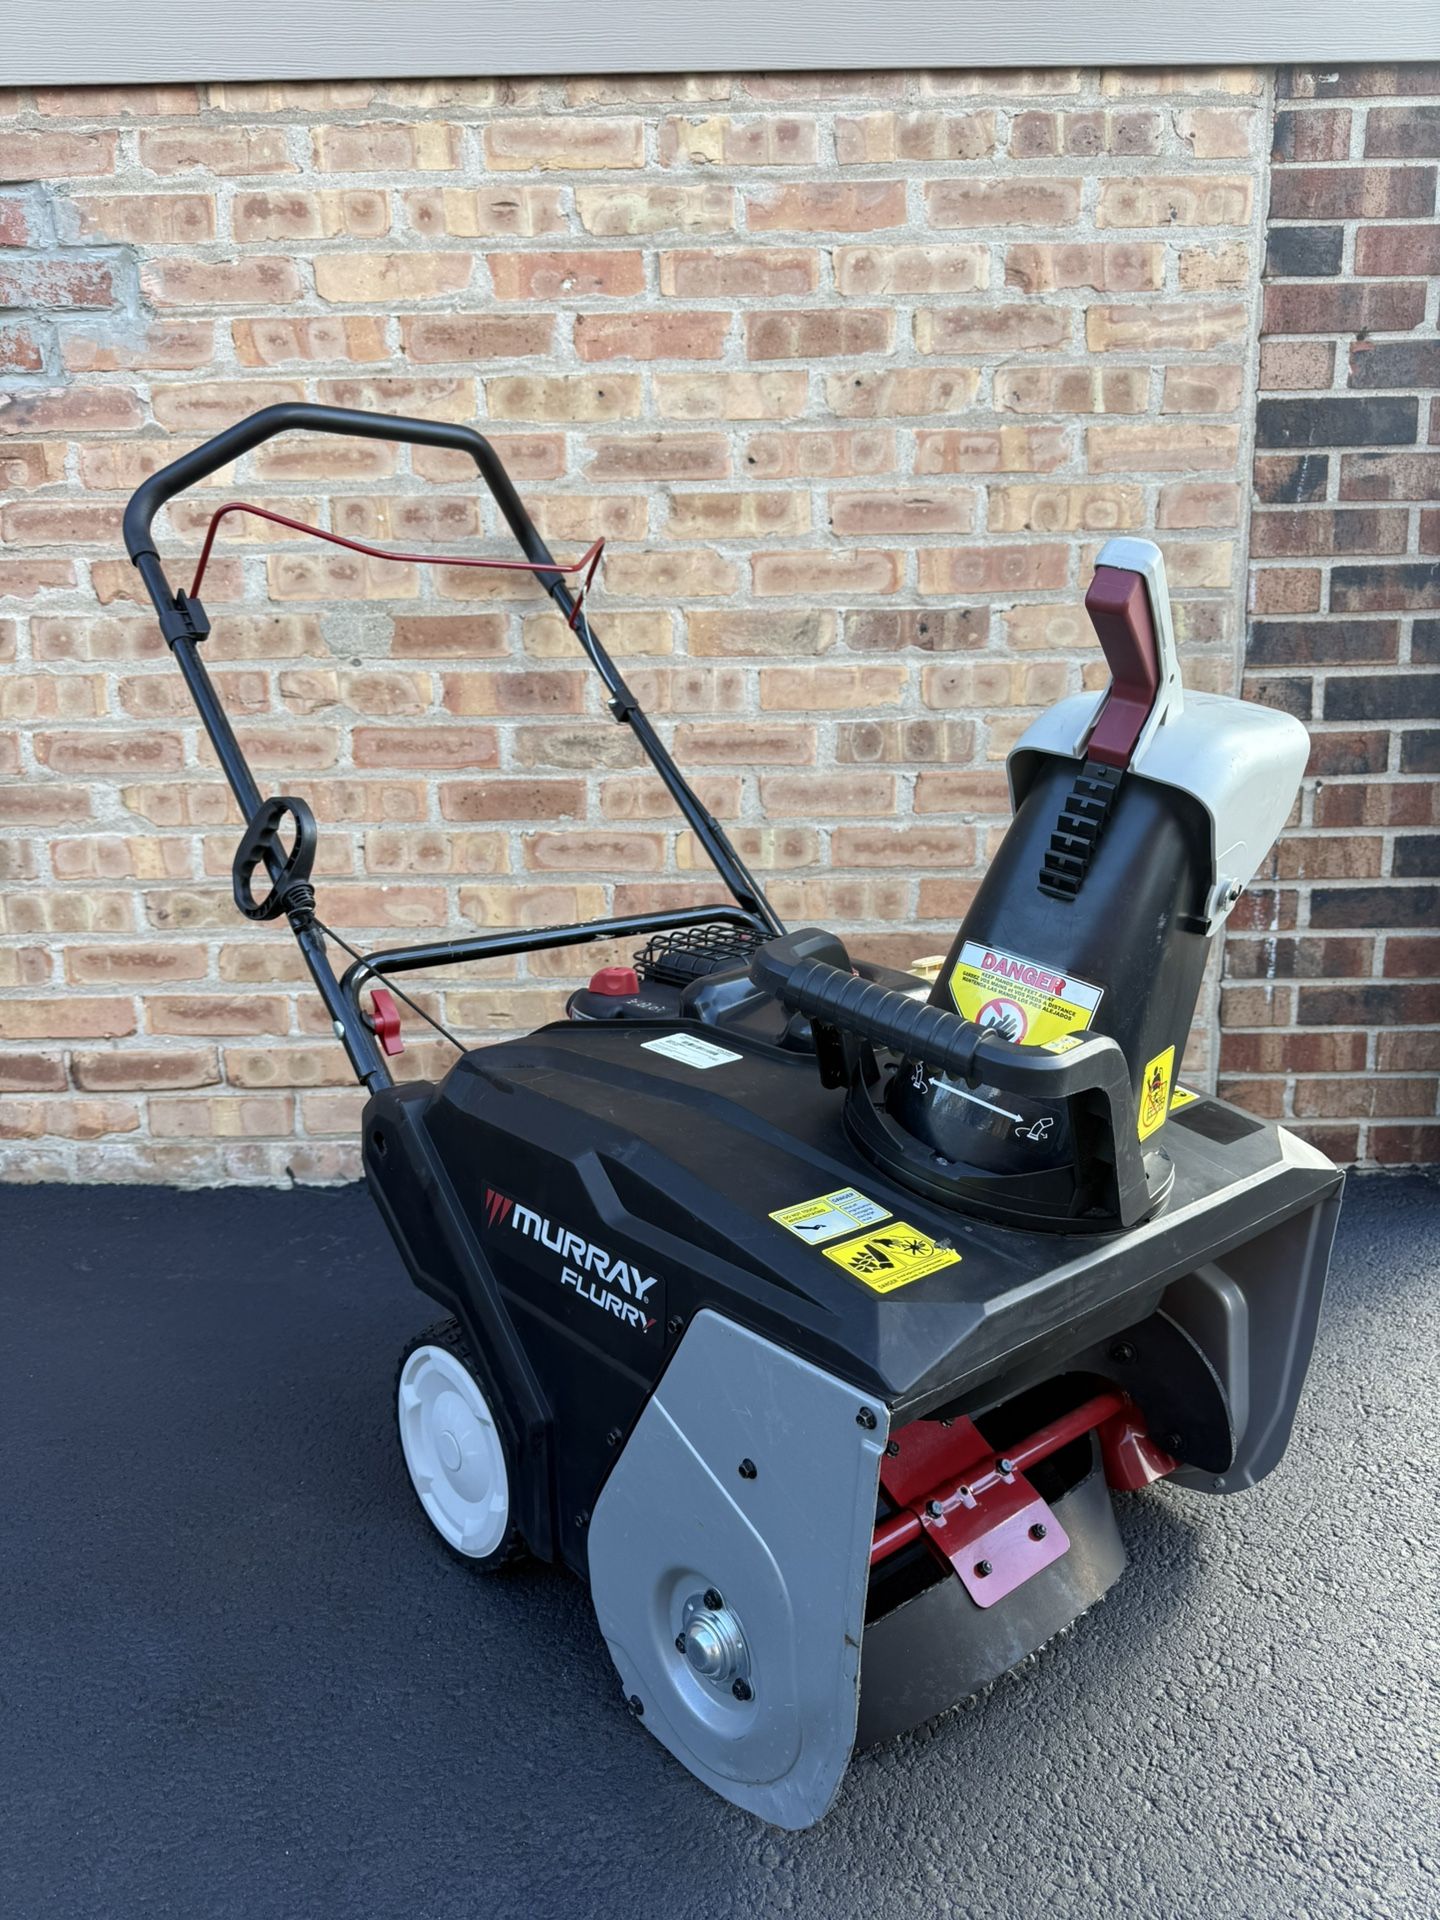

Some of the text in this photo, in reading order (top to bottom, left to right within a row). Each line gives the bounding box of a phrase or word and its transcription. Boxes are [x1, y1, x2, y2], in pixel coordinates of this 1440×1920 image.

[962, 970, 980, 981] GARDEZ
[980, 977, 990, 985] VOS
[991, 980, 1008, 991] MAINS
[1014, 989, 1026, 998] VOS
[1026, 993, 1042, 1004] PIEDS
[1048, 1002, 1076, 1017] DISTANCE
[981, 952, 1067, 996] DANGER
[981, 972, 1056, 1002] KEEP HANDS and FEET AWAY
[962, 976, 987, 989] MANTENGA
[987, 983, 998, 993] LAS
[998, 988, 1018, 1000] MANOS
[1017, 994, 1029, 1004] LOS
[1042, 1005, 1072, 1021] ALEJADOS
[512, 1203, 658, 1300] MURRAY
[560, 1266, 657, 1334] FLURRY
